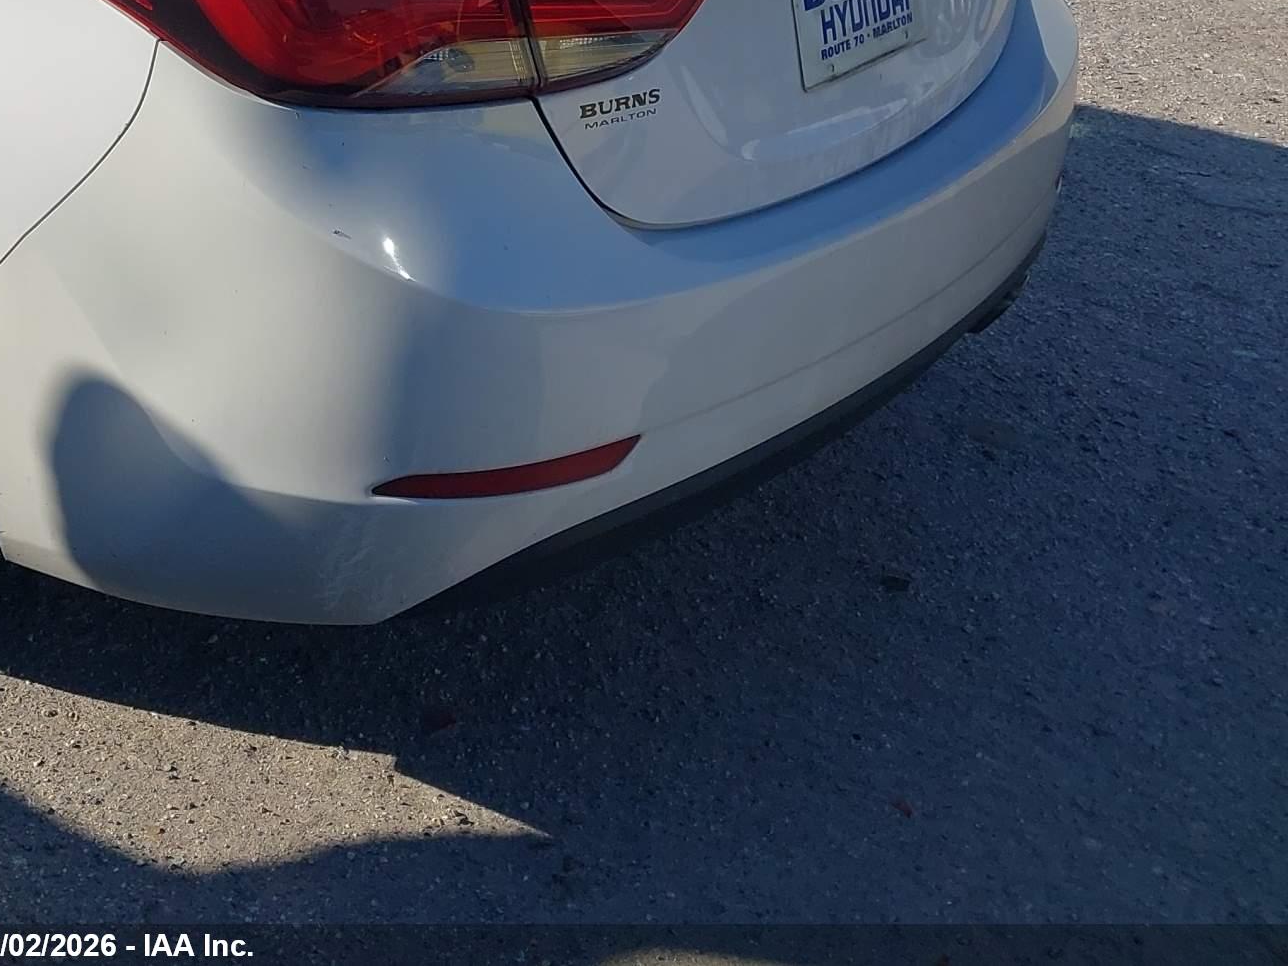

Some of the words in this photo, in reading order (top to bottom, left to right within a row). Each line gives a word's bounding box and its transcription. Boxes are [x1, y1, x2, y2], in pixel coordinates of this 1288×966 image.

[821, 37, 851, 60] ROUTE
[854, 33, 865, 45] 70
[872, 13, 913, 39] MARLTON
[579, 88, 661, 119] BURNS
[585, 108, 657, 130] MARLTON
